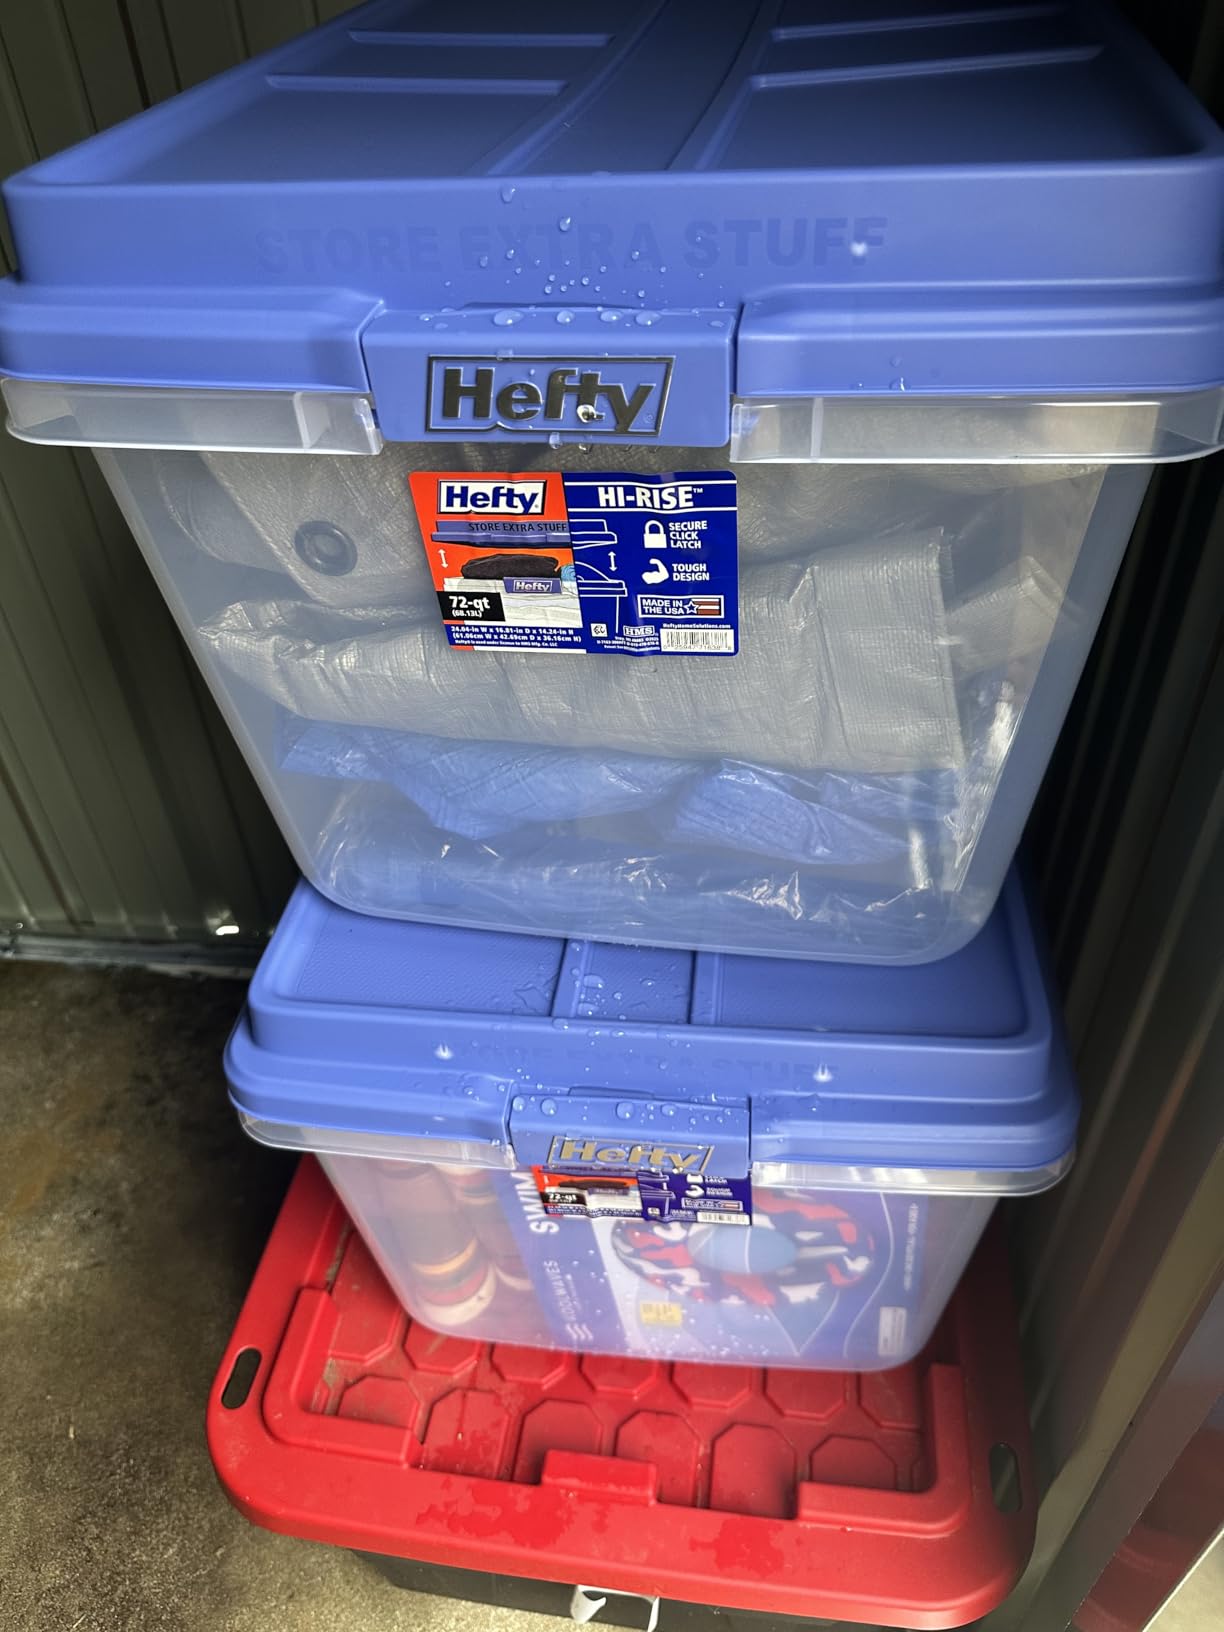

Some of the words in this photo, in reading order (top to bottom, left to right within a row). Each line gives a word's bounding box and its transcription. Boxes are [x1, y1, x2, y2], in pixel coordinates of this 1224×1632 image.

[256, 226, 440, 273] STORE
[460, 223, 664, 272] EXTRA
[683, 217, 889, 270] STUFF
[442, 367, 656, 432] Hefty
[468, 523, 500, 532] STORE
[503, 522, 535, 532] EXTRA
[537, 522, 567, 532] STUFF
[669, 520, 708, 531] SECURE
[670, 531, 698, 540] CLICK
[670, 540, 701, 549] LATCH
[672, 563, 707, 572] TOUGH
[673, 572, 710, 581] DESIGN
[516, 581, 550, 591] Hefty
[449, 596, 490, 612] 72-qt
[642, 599, 670, 607] MADE
[643, 606, 662, 614] THE
[625, 627, 653, 636] HMS
[559, 1139, 700, 1171] Hefty
